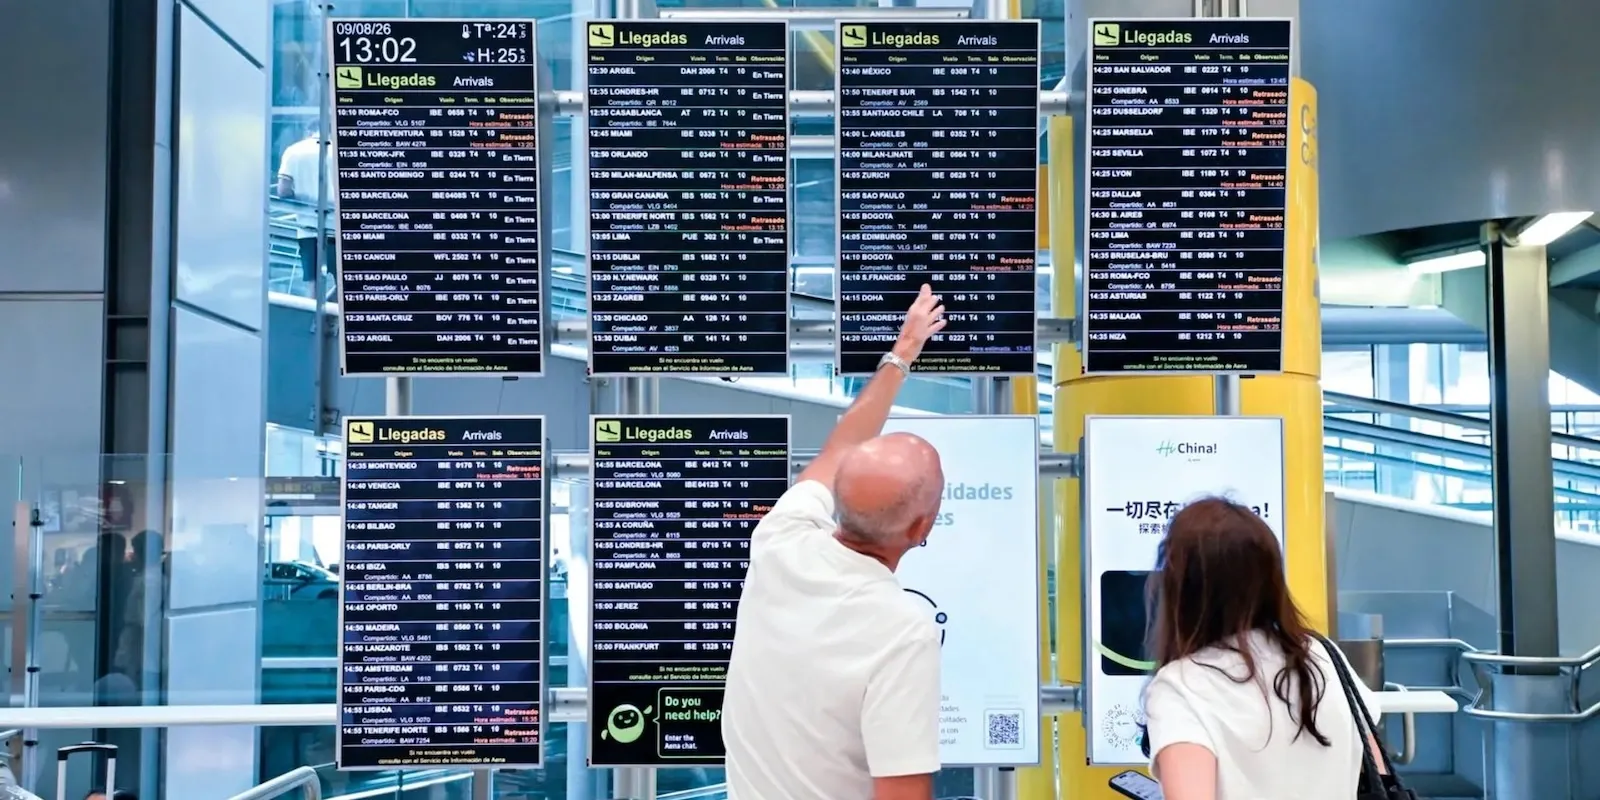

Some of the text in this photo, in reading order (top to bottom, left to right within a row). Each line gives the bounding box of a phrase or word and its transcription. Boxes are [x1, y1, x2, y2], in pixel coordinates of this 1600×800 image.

[336, 23, 391, 35] 09/08/26
[619, 31, 688, 48] Llegadas
[704, 35, 745, 45] Arrivals
[872, 32, 940, 48] Llegadas
[957, 35, 997, 46] Arrivals
[1124, 30, 1192, 46] Llegadas
[1209, 34, 1249, 44] Arrivals
[339, 37, 417, 63] 13:02
[862, 67, 891, 75] MÉXICO
[367, 73, 436, 89] Llegadas
[453, 76, 494, 87] Arrivals
[339, 150, 358, 158] 11:35
[340, 171, 359, 179] 11:45
[360, 171, 386, 179] SANTO
[387, 171, 425, 179] DOMINGO
[379, 428, 445, 444] Llegadas
[462, 431, 502, 440] Arrivals
[626, 427, 692, 443] Llegadas
[709, 430, 748, 440] Arrivals
[1177, 443, 1217, 454] China!
[347, 462, 367, 470] 14:35
[621, 520, 654, 528] CORUÑA
[665, 696, 701, 709] Do you
[665, 710, 720, 721] need help?
